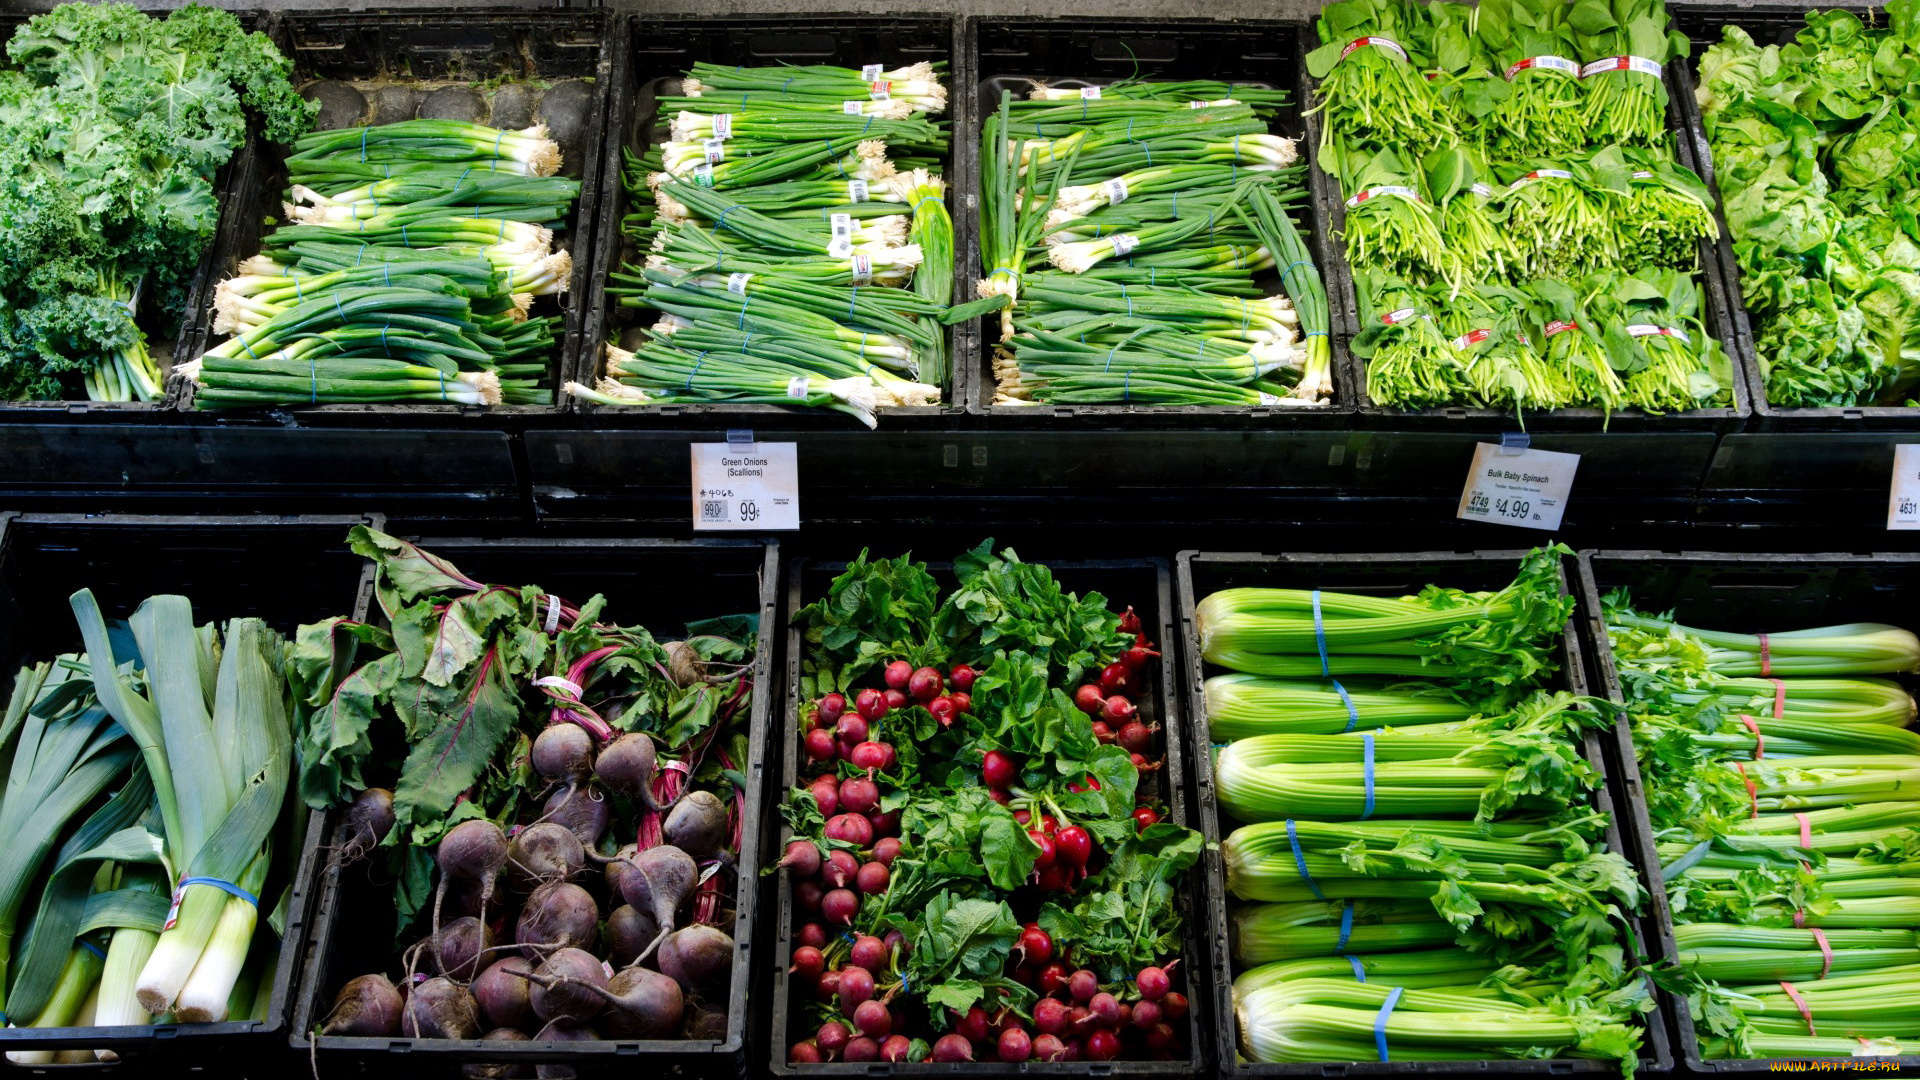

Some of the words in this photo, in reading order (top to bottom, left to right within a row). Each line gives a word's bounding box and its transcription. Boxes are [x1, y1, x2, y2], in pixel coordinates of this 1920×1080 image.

[721, 457, 742, 466] Green
[743, 457, 768, 466] Onions
[727, 467, 763, 478] (Scallions)
[1488, 469, 1503, 477] Bulk
[1504, 471, 1521, 482] Baby
[1522, 473, 1549, 483] Spinach
[1471, 496, 1489, 507] 4749
[740, 502, 760, 521] 99¢
[1496, 498, 1529, 518] $4.99
[1532, 513, 1542, 521] lb.
[1899, 502, 1918, 515] 4631
